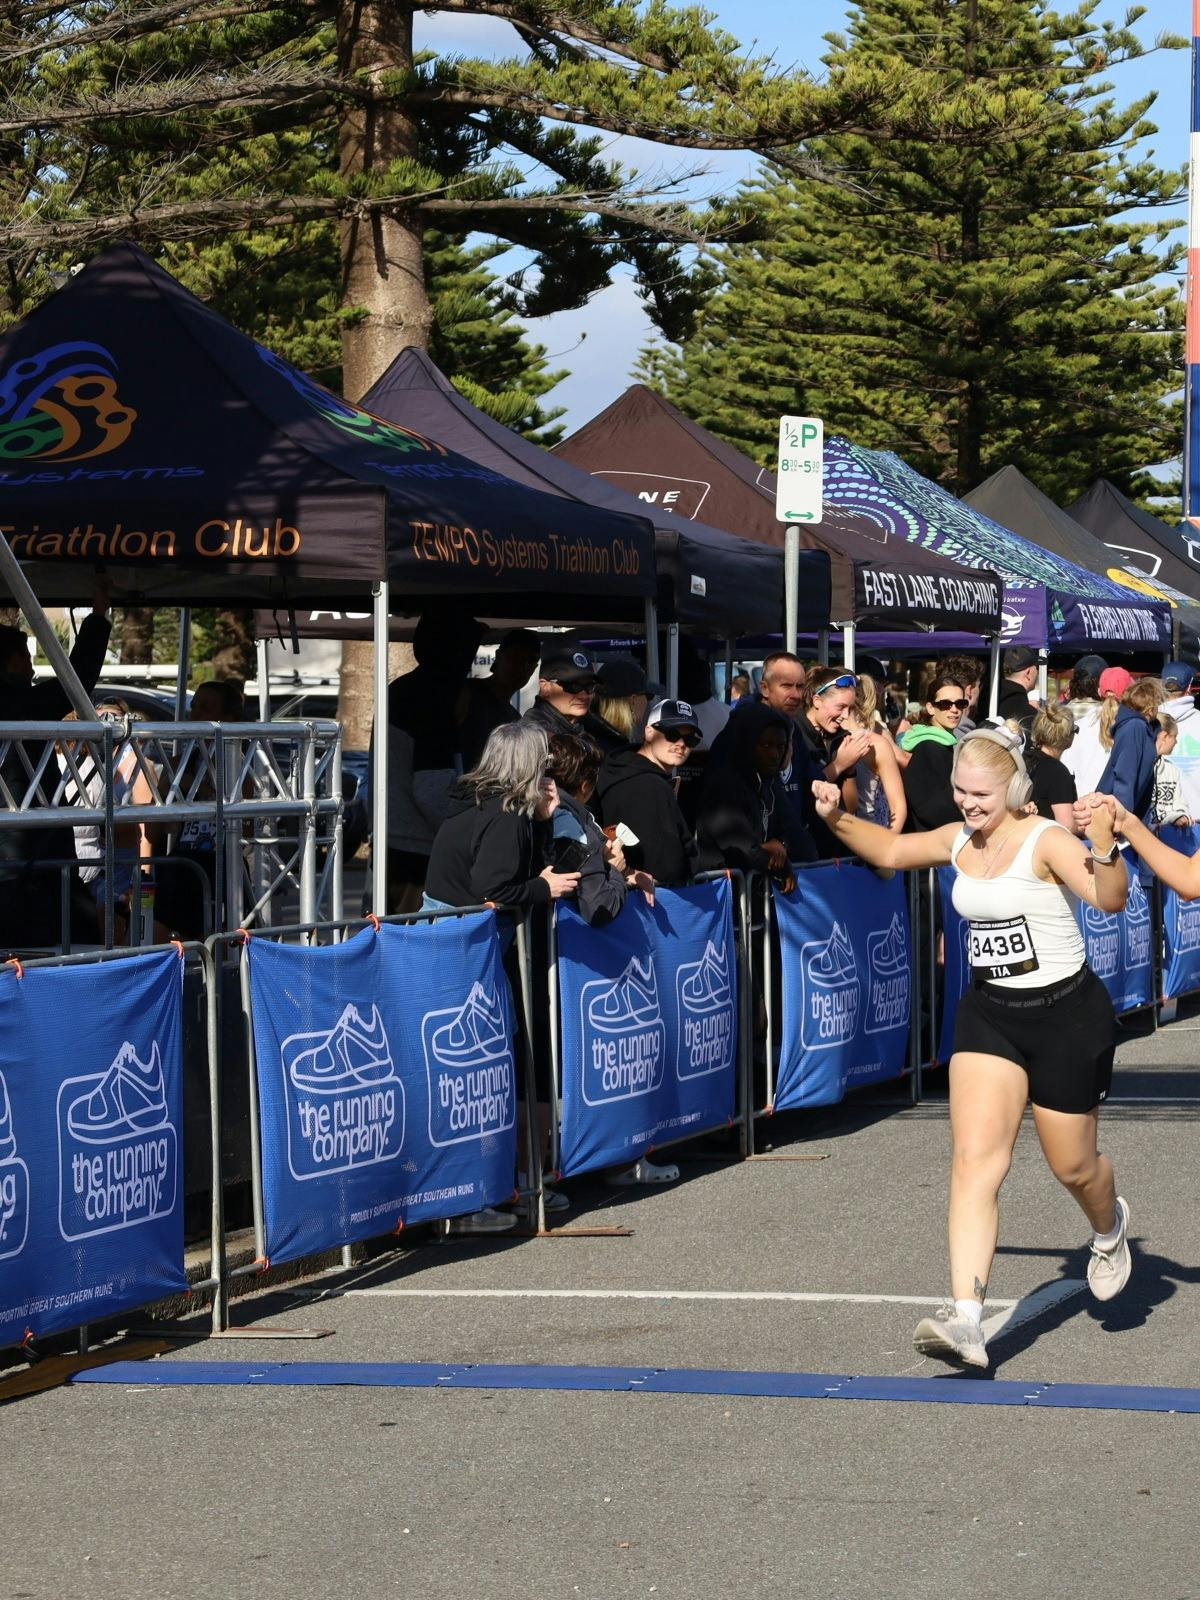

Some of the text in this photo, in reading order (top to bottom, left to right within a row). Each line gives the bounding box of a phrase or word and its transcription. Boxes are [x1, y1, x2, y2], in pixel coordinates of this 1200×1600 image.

[195, 518, 301, 557] Club
[408, 521, 640, 576] TEMPO Systems Triathlon Club
[862, 570, 998, 616] FAST LANE COACHING
[973, 933, 1026, 957] 3438
[1088, 935, 1099, 956] the
[873, 979, 886, 1004] the
[990, 966, 1011, 978] TIA
[811, 987, 857, 1019] the running
[684, 1011, 731, 1047] the running
[592, 1030, 660, 1070] the running
[438, 1063, 510, 1107] the running
[298, 1090, 395, 1137] the running
[71, 1138, 168, 1193] the running
[350, 1205, 372, 1224] PROUDLY
[402, 1192, 423, 1208] GREAT
[423, 1186, 457, 1203] SOUTHERN
[457, 1183, 474, 1196] RUNS
[29, 1297, 54, 1314] GREAT
[55, 1288, 94, 1308] SOUTHERN
[94, 1282, 113, 1297] RUNS
